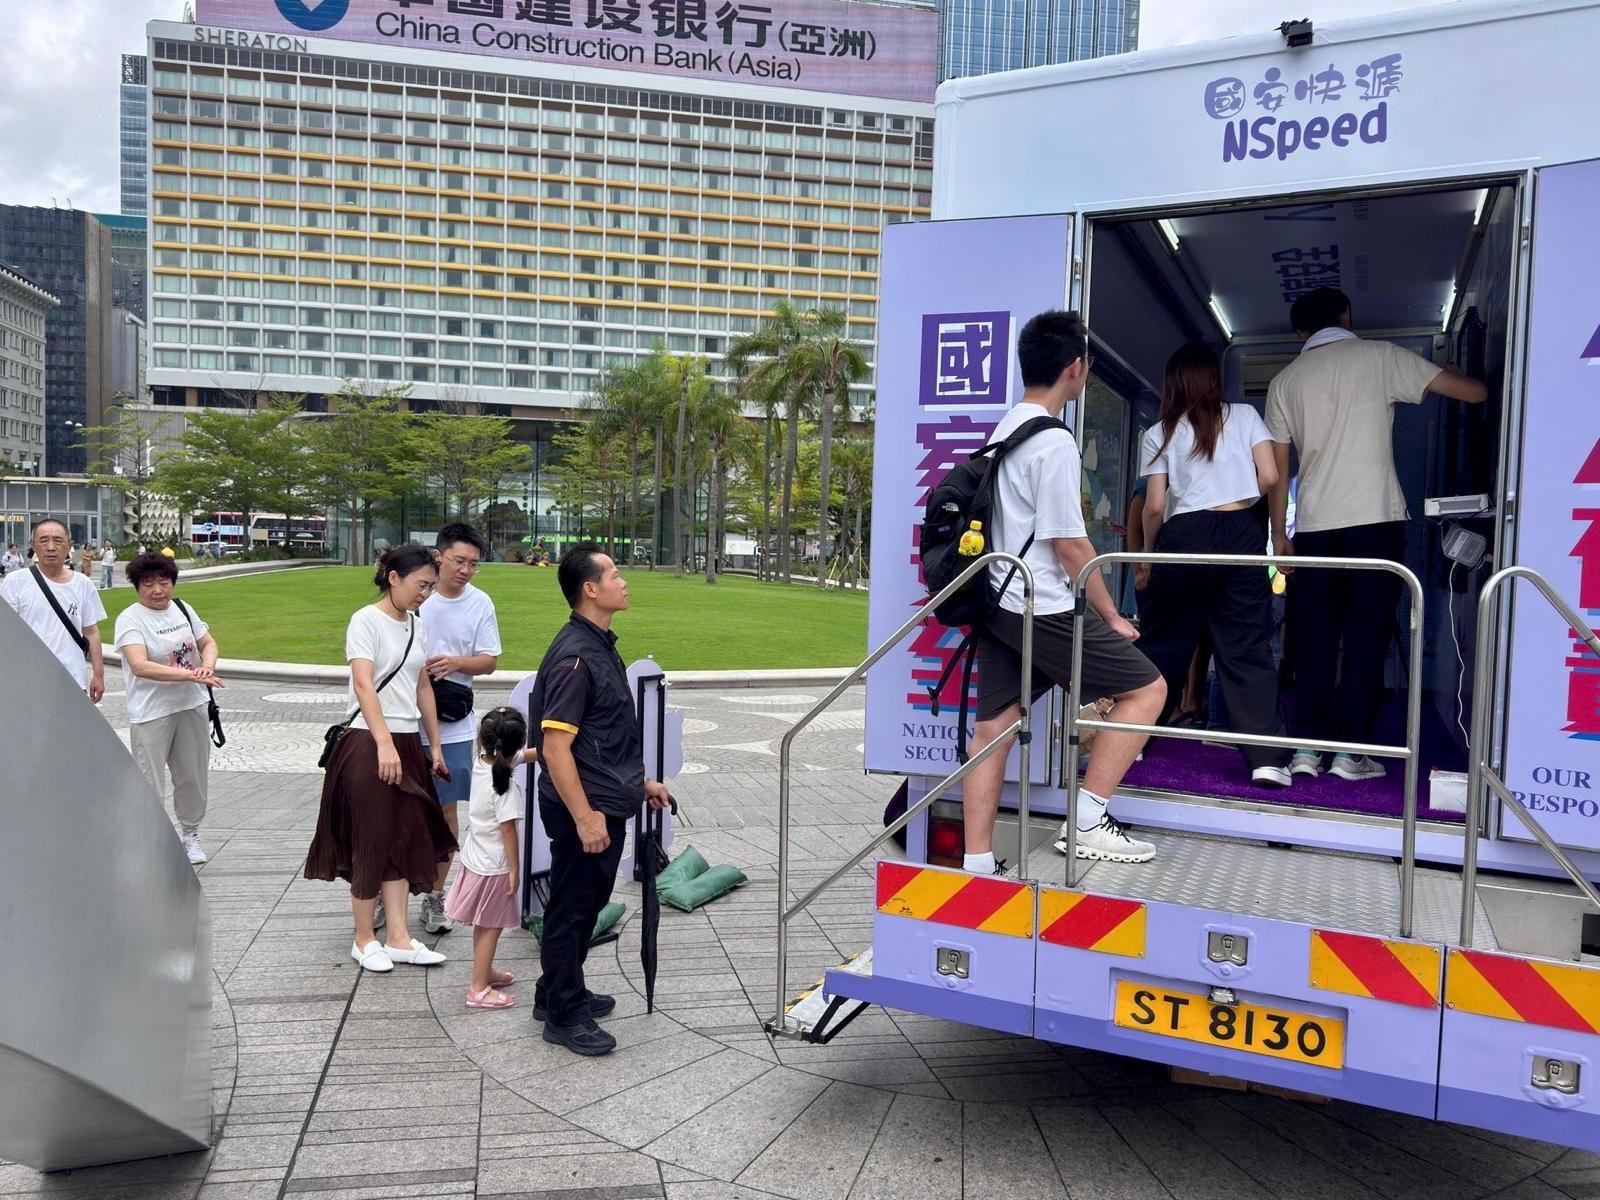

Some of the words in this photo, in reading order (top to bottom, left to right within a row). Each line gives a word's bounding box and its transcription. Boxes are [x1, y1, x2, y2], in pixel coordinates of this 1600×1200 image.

[195, 27, 307, 52] SHERATON
[375, 12, 461, 43] China
[472, 23, 644, 63] Construction
[654, 43, 723, 72] Bank
[728, 50, 802, 82] (Asia)
[1204, 53, 1404, 120] 國安快遞
[1223, 102, 1387, 162] NSpeed
[1532, 767, 1591, 789] OUR
[1130, 990, 1189, 1030] ST
[1208, 1005, 1326, 1057] 8130
